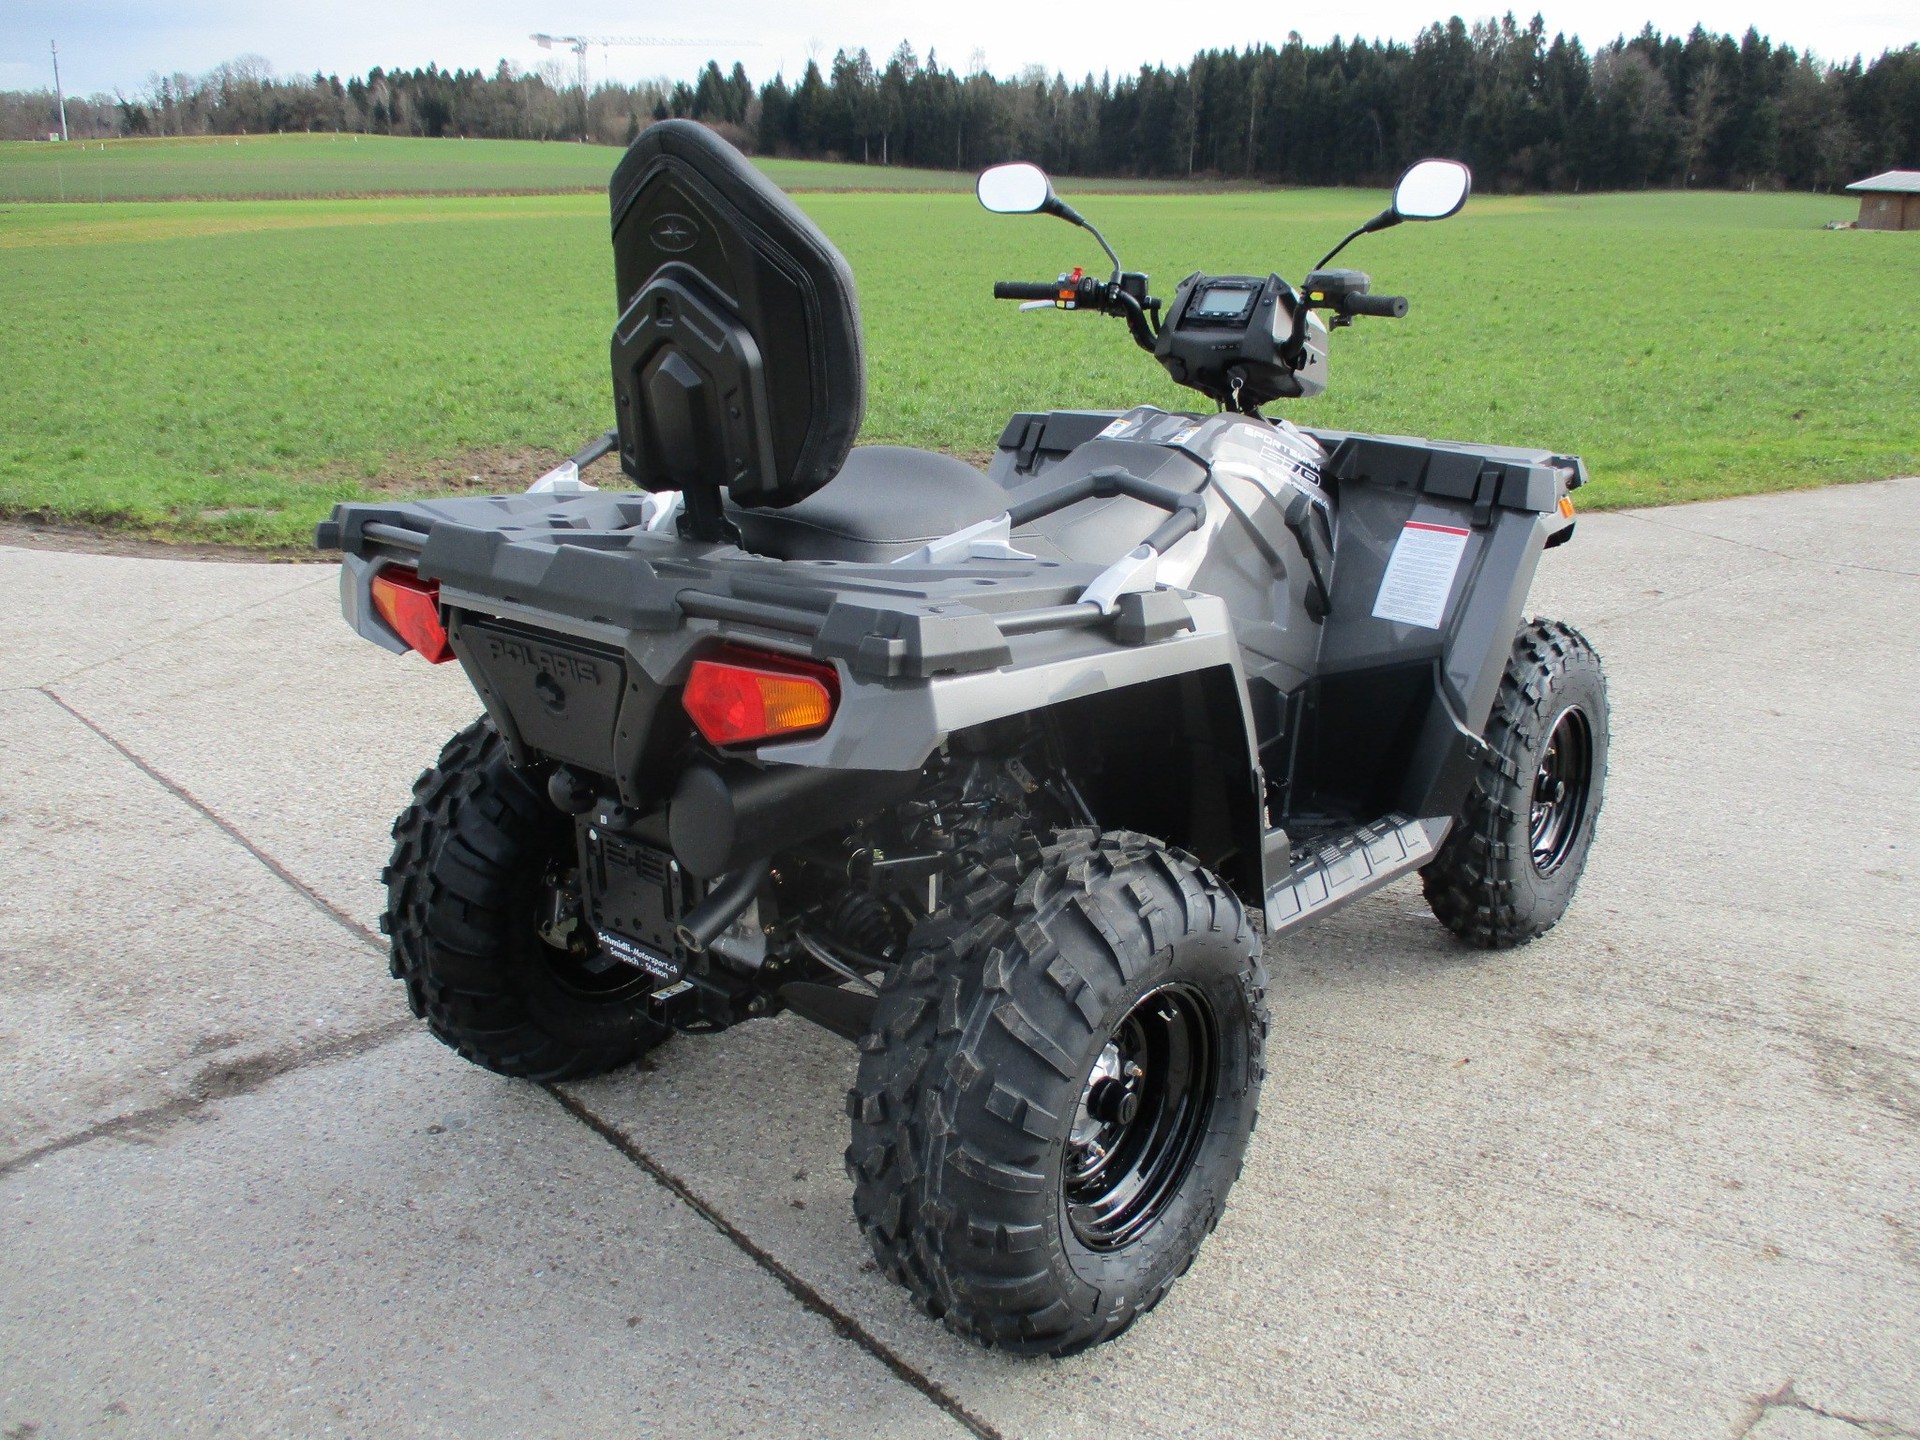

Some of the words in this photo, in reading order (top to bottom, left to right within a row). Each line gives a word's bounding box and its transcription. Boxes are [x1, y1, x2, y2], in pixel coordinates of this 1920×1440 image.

[1243, 426, 1320, 472] SPORTSMAN
[1260, 445, 1321, 488] 570
[486, 636, 601, 686] POLARIS
[598, 931, 678, 974] Schmidli-Motorsport.ch
[610, 946, 639, 966] Sempach
[645, 962, 669, 979] Station
